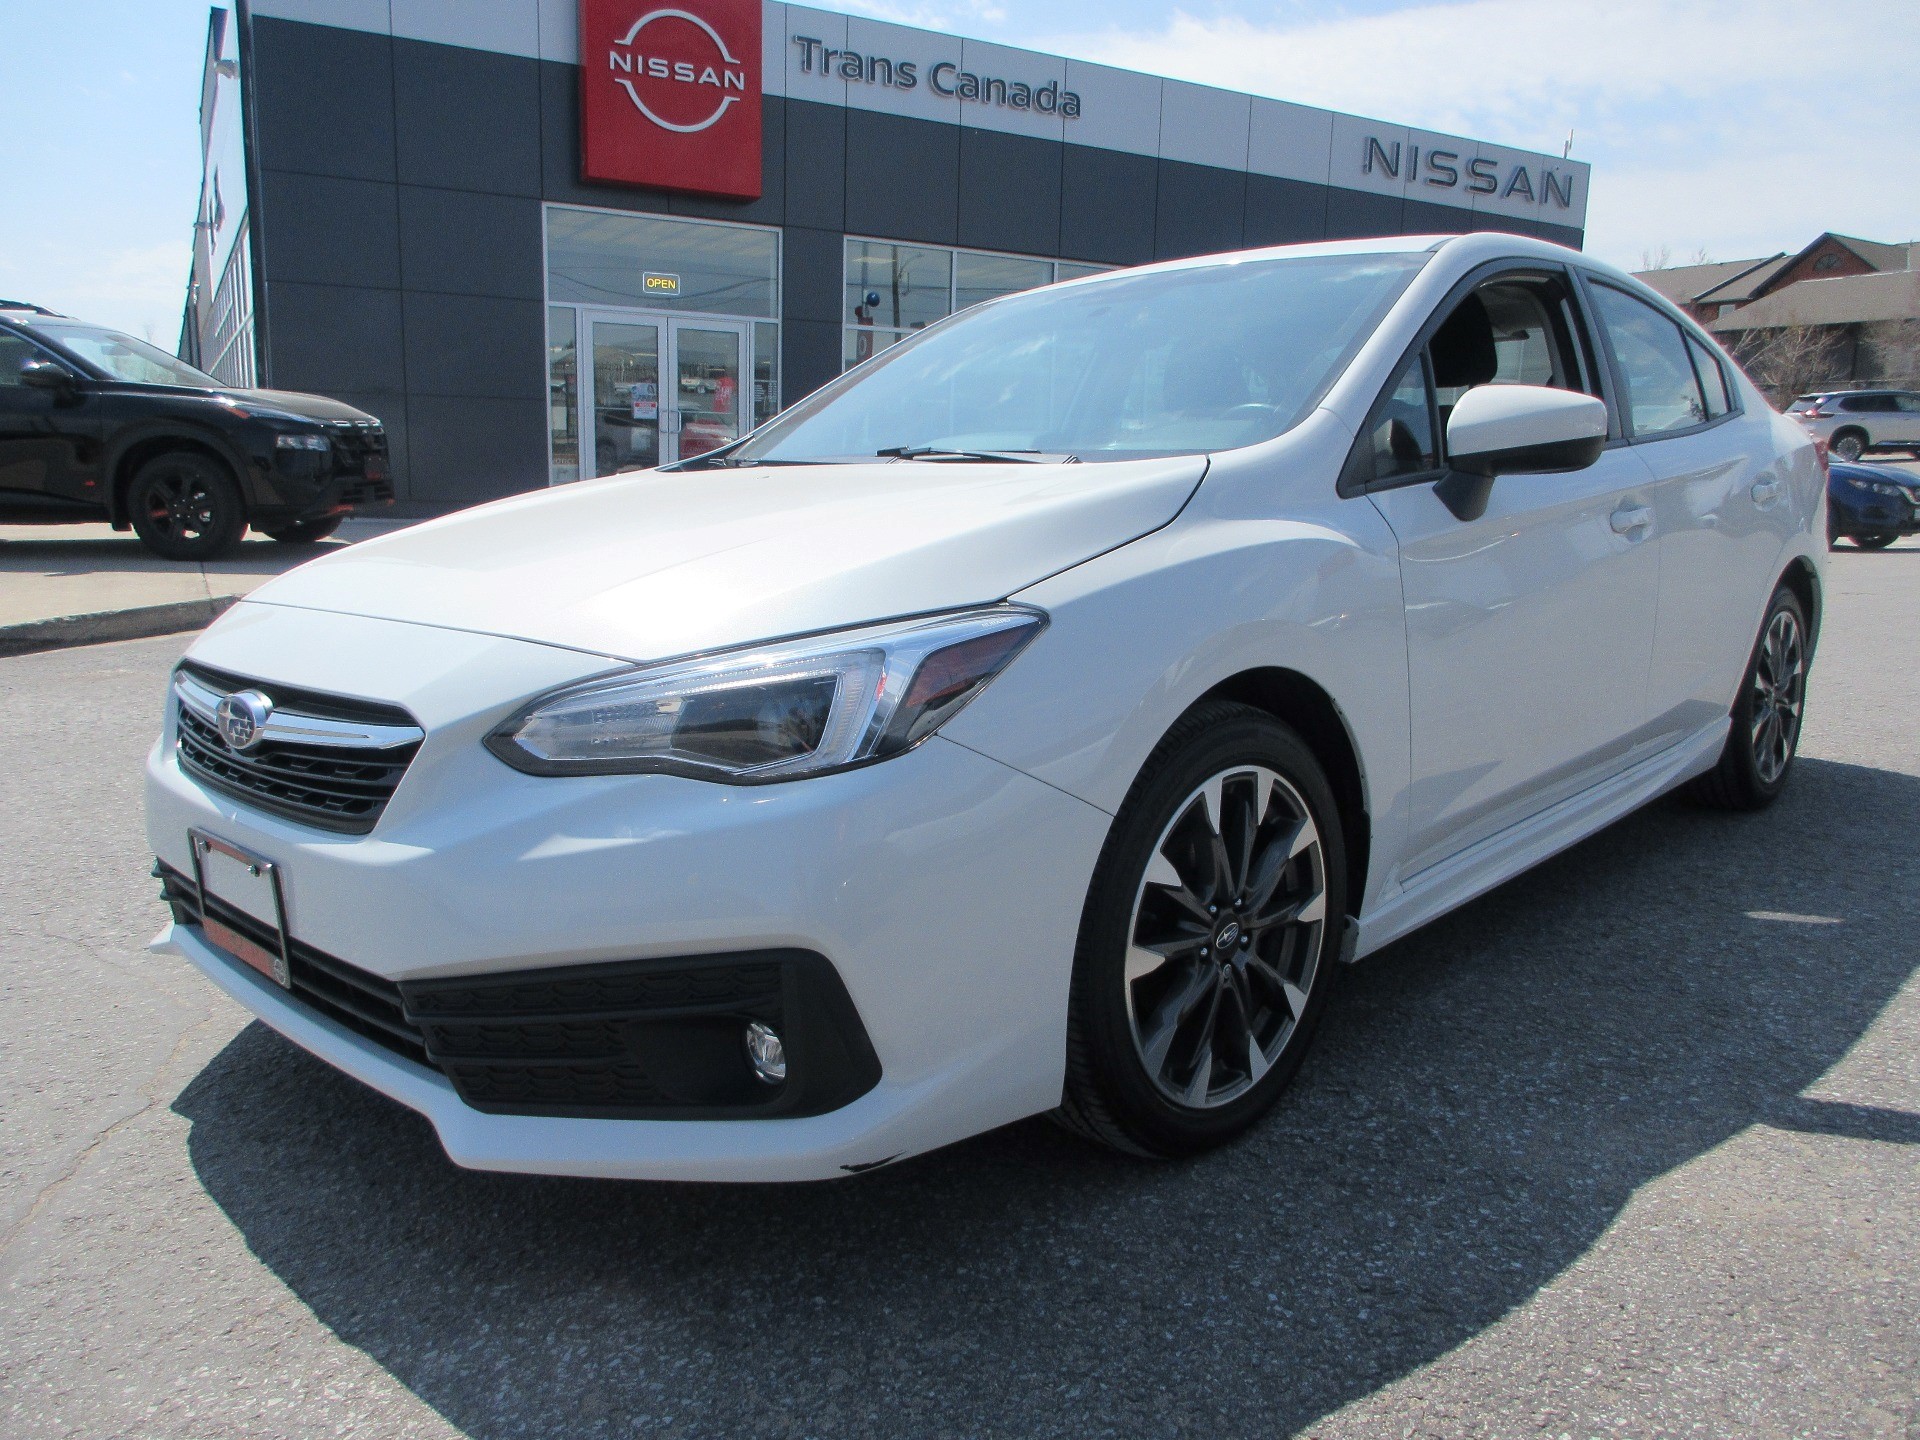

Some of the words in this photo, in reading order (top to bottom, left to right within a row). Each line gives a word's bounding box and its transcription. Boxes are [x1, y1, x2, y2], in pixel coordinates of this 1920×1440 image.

[610, 51, 745, 90] NISSAN
[793, 35, 918, 90] Trans
[929, 62, 1081, 118] Canada
[1365, 137, 1573, 208] NISSAN
[646, 278, 676, 289] OPEN
